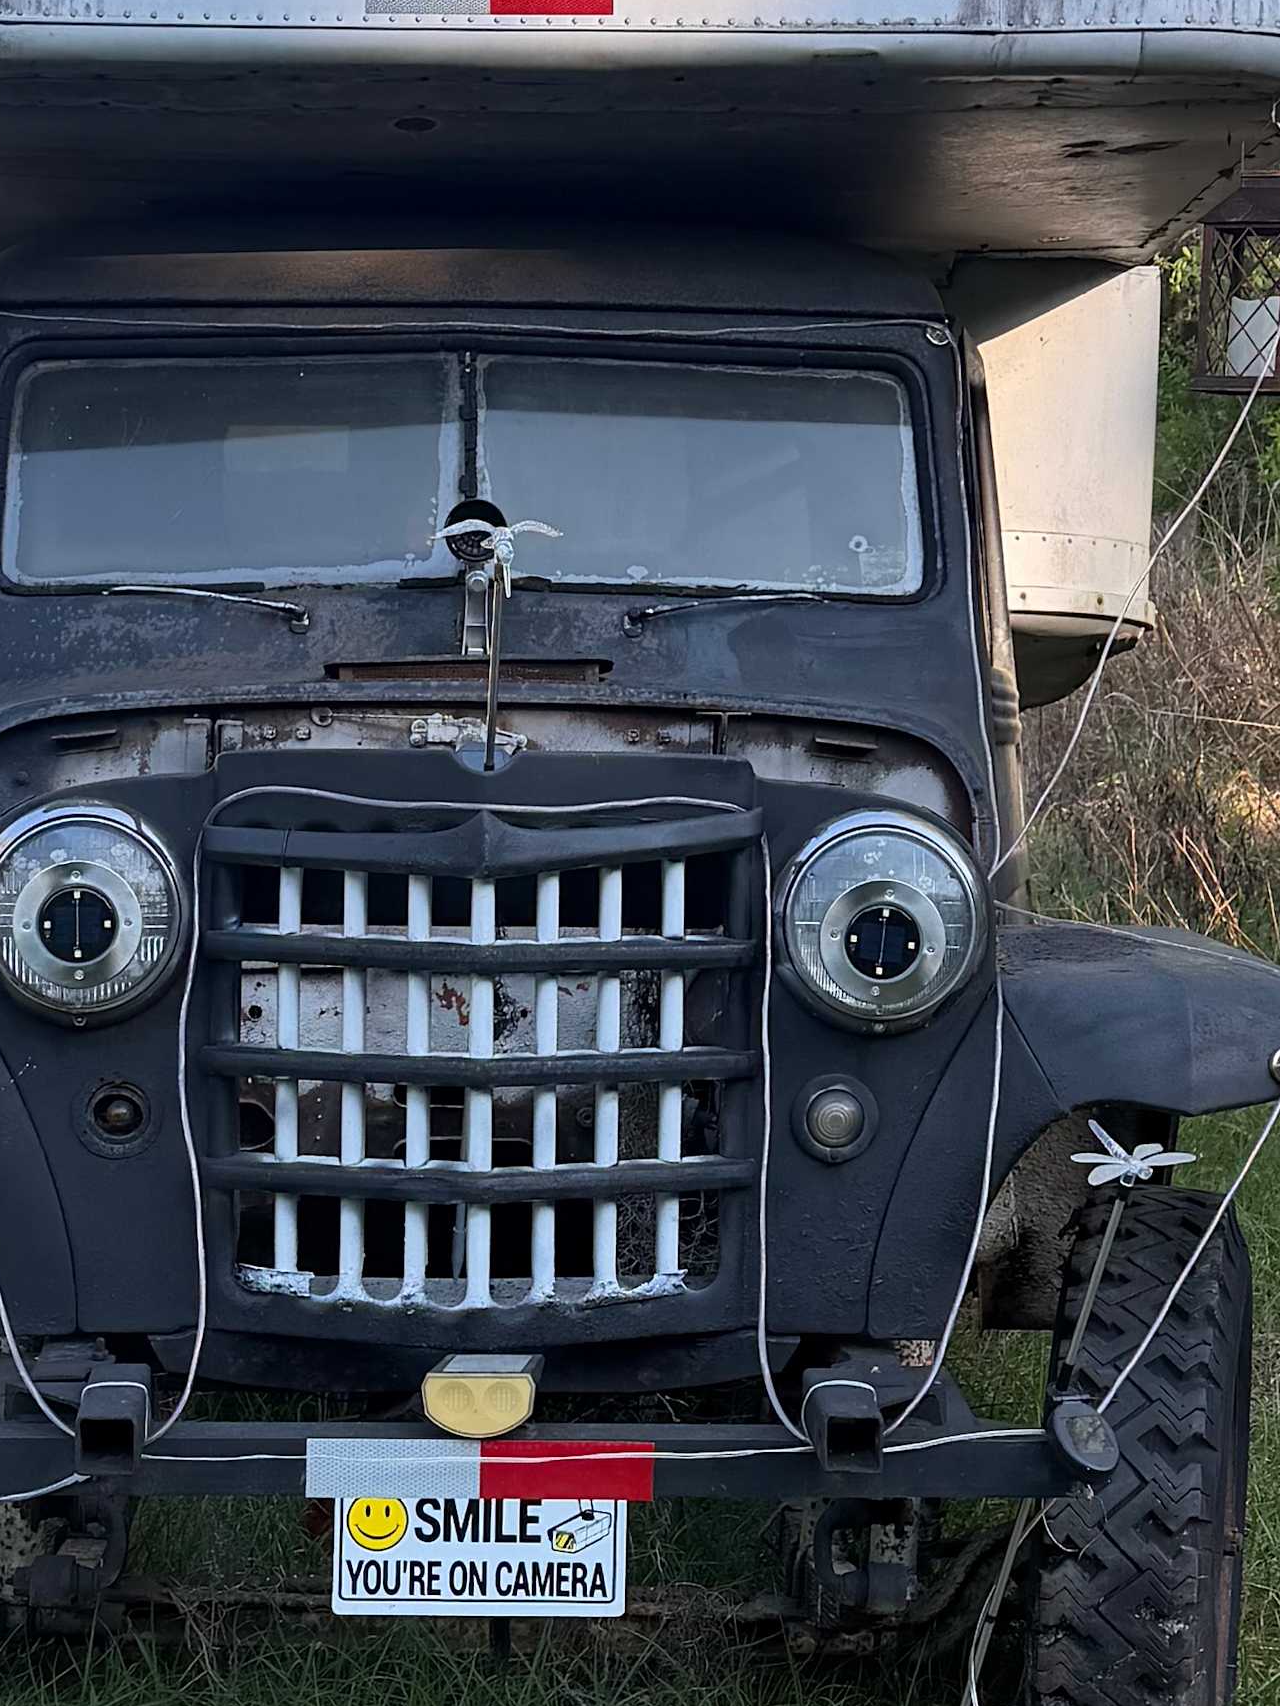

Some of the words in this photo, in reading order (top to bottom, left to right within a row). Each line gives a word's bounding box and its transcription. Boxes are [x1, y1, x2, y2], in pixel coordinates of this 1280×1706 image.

[414, 1497, 543, 1544] SMILE
[346, 1559, 442, 1596] YOU'RE
[448, 1560, 488, 1596] ON
[494, 1561, 608, 1599] CAMERA
